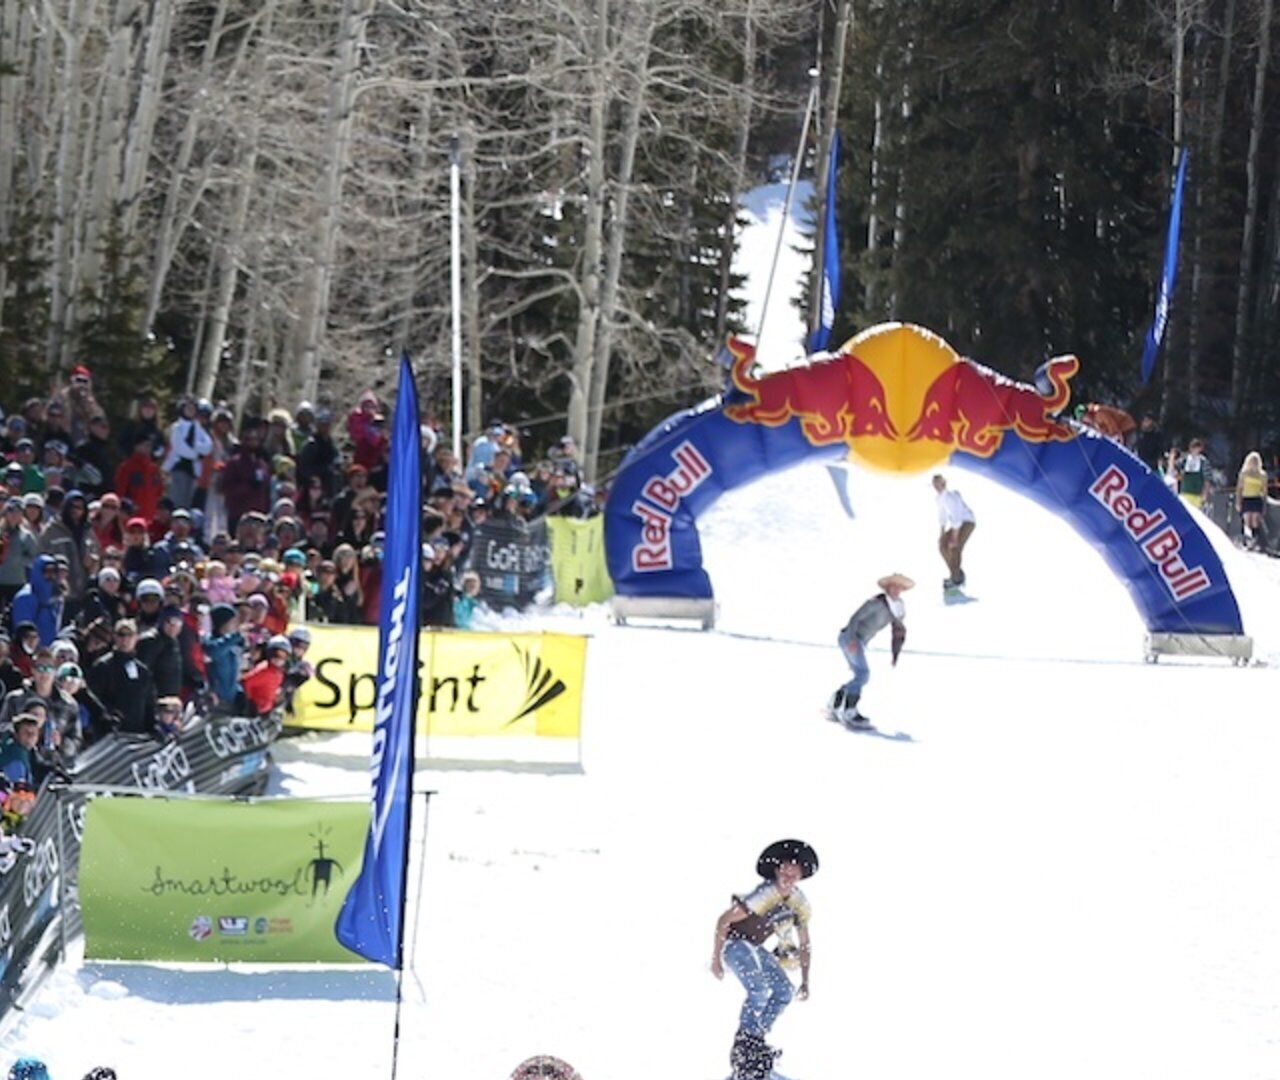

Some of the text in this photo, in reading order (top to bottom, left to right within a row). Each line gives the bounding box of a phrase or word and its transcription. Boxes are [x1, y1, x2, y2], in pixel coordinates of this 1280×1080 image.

[632, 440, 713, 573] Red Bull
[1088, 463, 1211, 602] Red Bull
[314, 657, 486, 724] Spint
